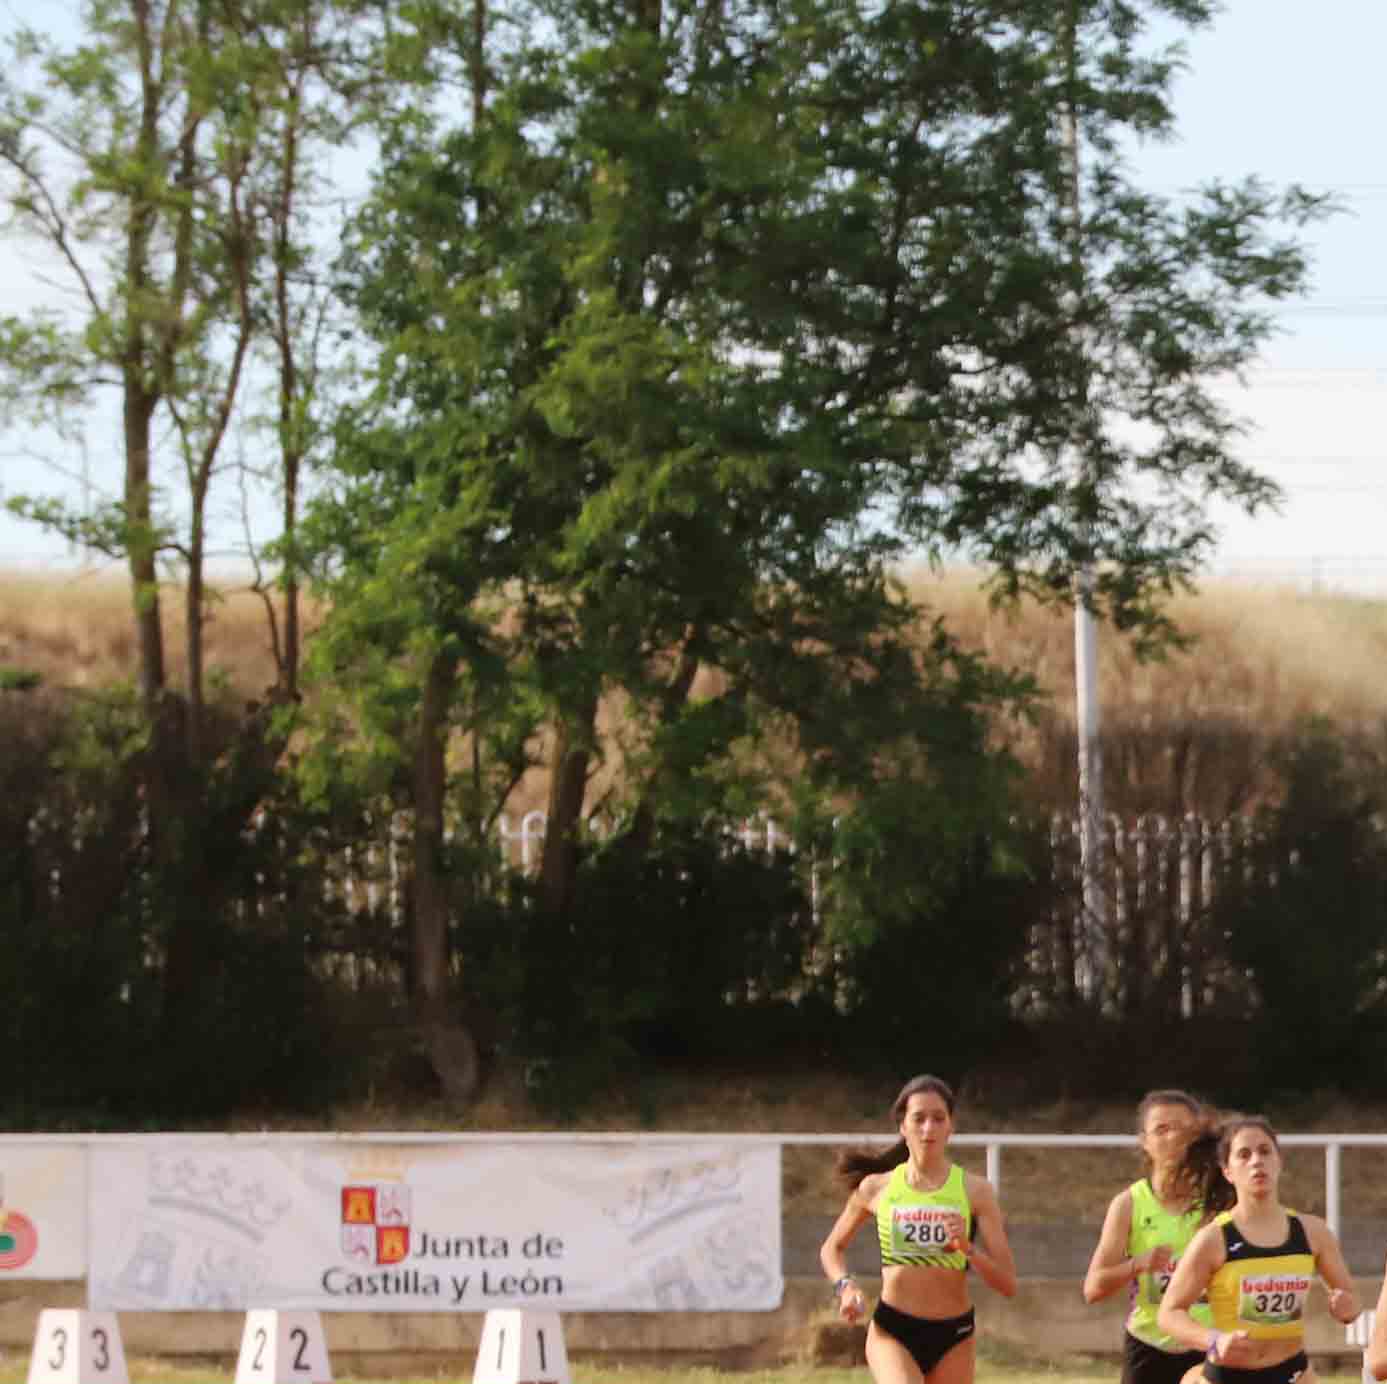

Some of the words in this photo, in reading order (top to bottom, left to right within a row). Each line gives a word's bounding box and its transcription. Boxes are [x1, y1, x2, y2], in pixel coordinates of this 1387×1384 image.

[413, 1233, 509, 1259] Junta
[521, 1233, 564, 1259] de
[903, 1223, 947, 1243] 280
[321, 1268, 441, 1296] Castilla
[450, 1275, 470, 1304] y
[481, 1268, 563, 1296] León
[1255, 1293, 1296, 1313] 320
[49, 1328, 67, 1372] 3
[92, 1328, 110, 1372] 3
[251, 1328, 266, 1372] 2
[290, 1328, 311, 1372] 2
[536, 1328, 547, 1372] 1
